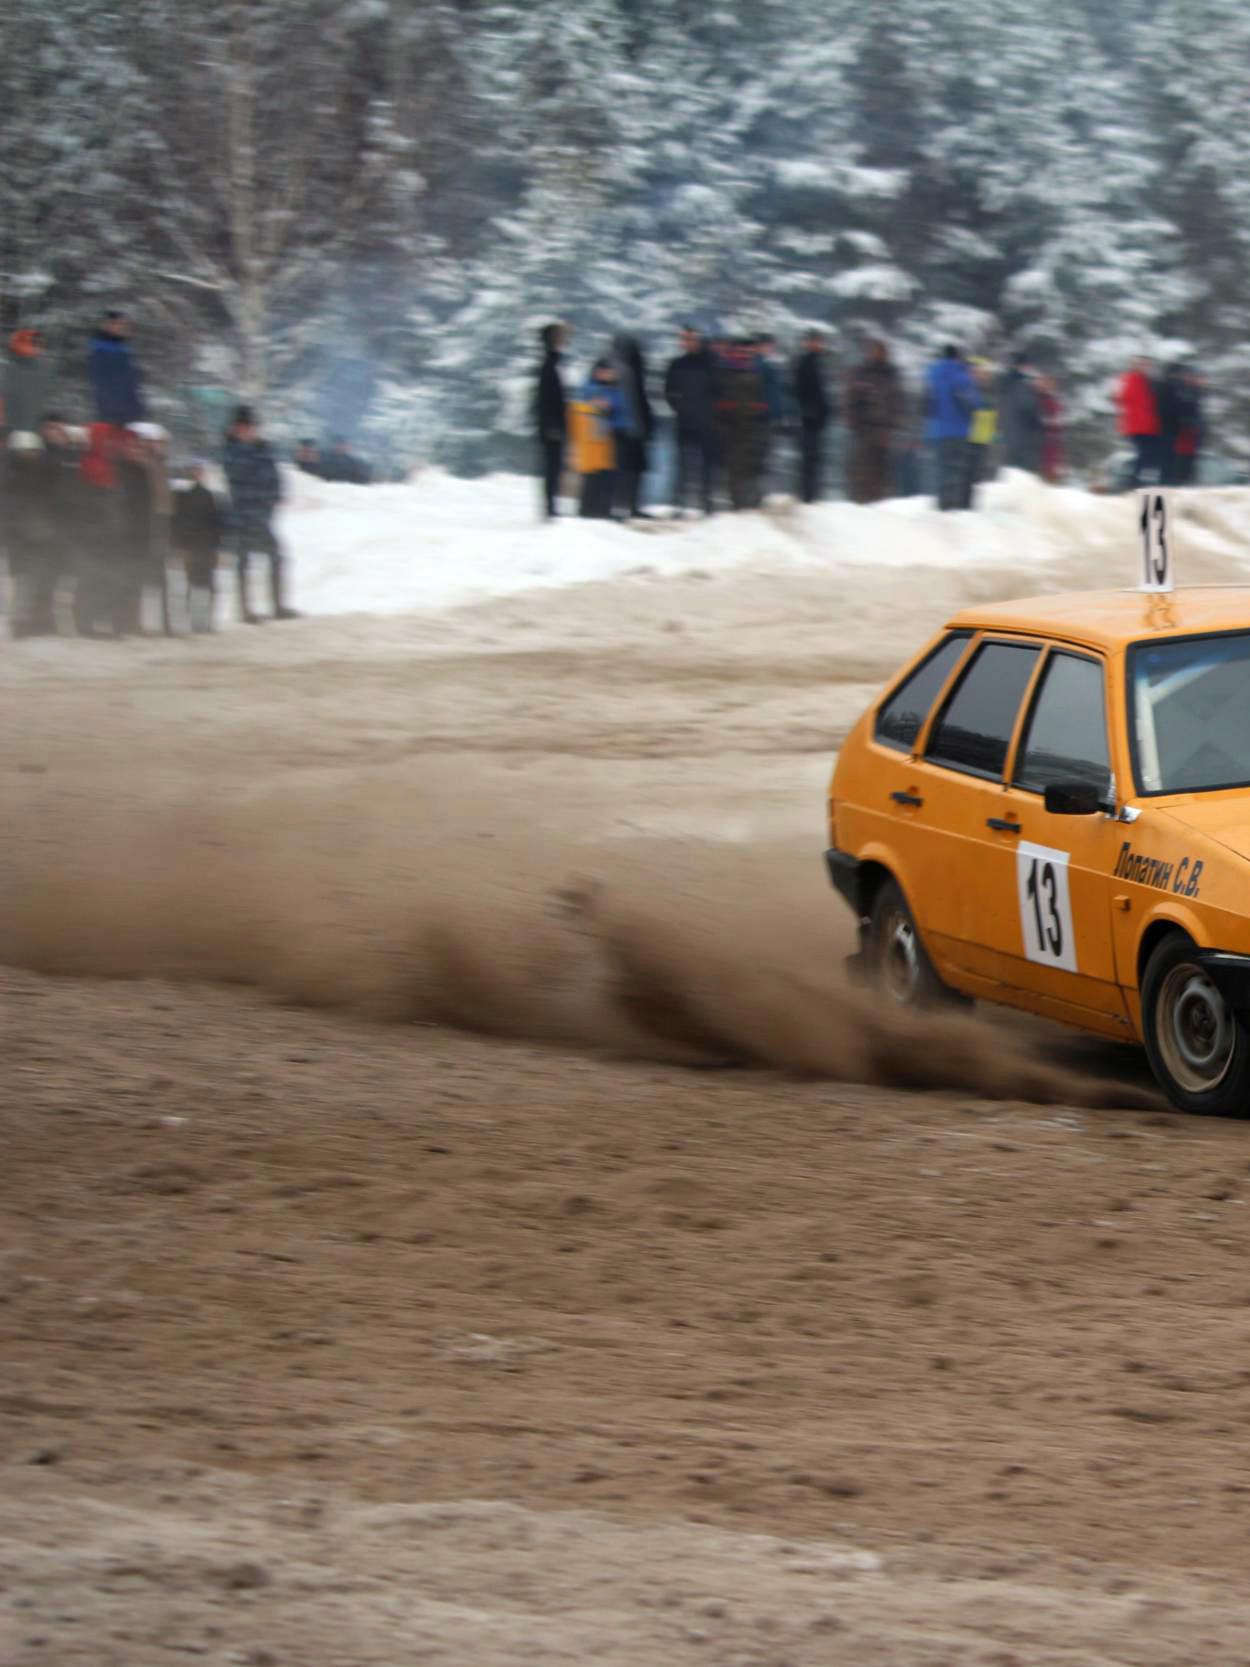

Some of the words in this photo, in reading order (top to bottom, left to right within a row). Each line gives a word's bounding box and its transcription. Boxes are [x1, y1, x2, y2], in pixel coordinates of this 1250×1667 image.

[1141, 494, 1167, 585] 13
[1026, 858, 1063, 958] 13
[1114, 841, 1174, 891] Лопатин
[1173, 856, 1204, 898] С.В.
